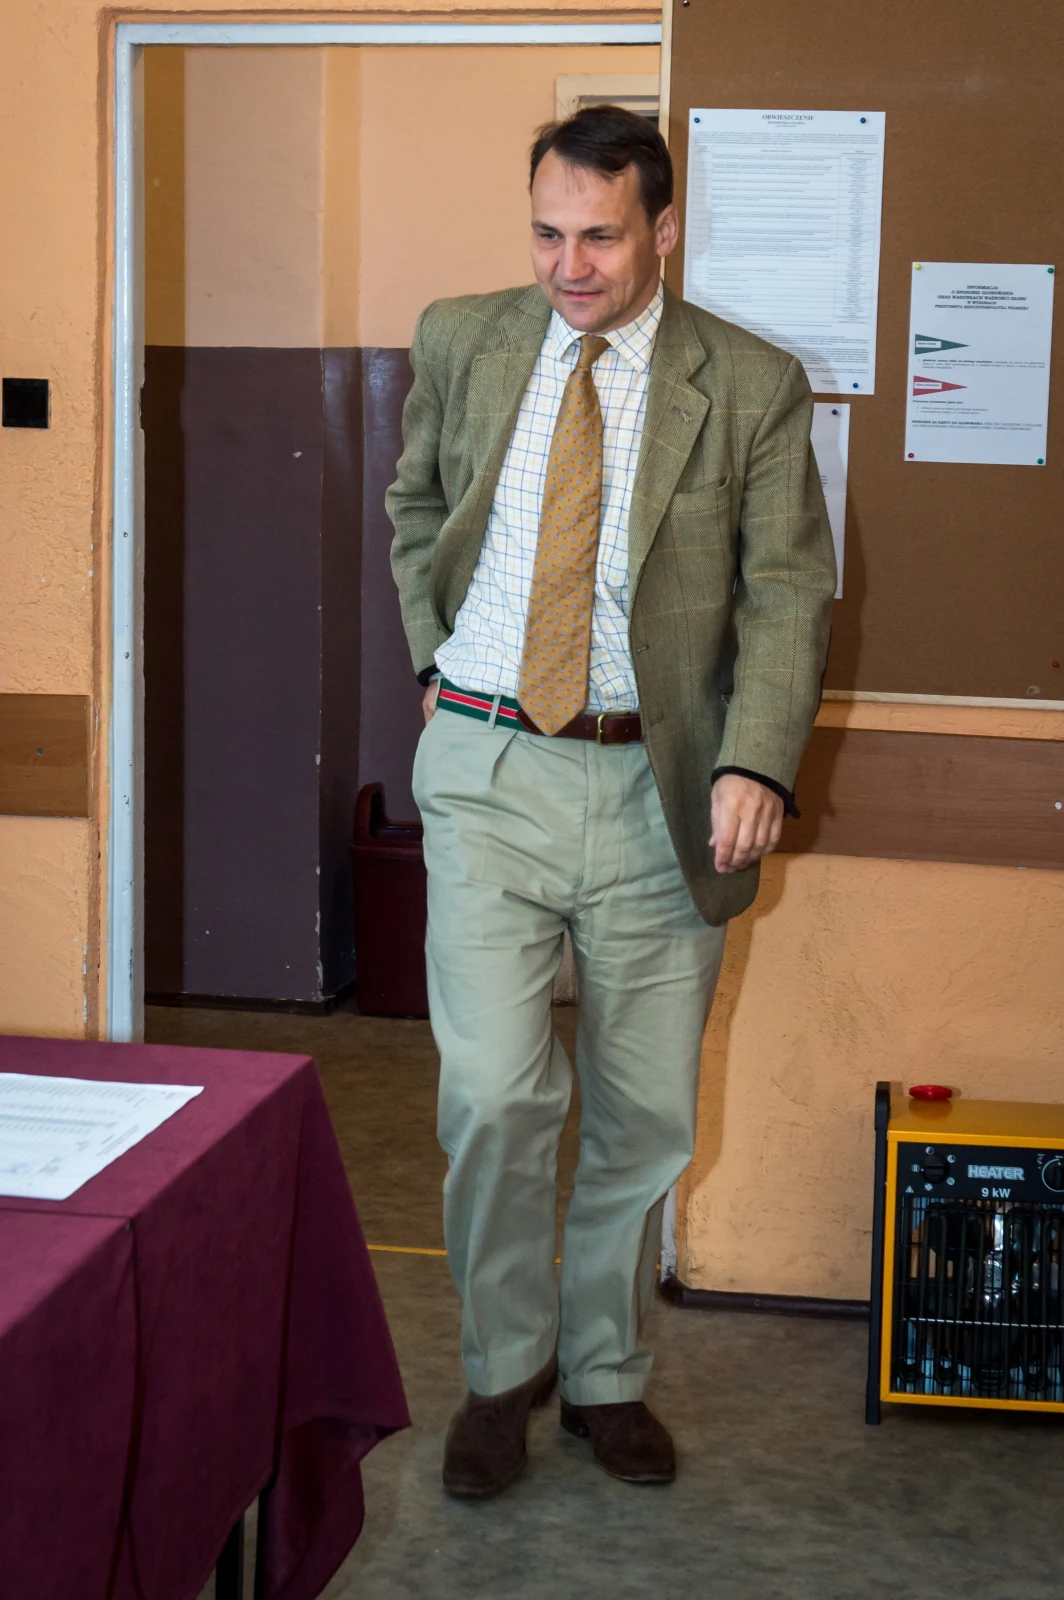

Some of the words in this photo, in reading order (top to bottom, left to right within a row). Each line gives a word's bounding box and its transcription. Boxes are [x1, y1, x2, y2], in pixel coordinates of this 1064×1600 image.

[968, 1165, 1025, 1180] HEATER
[981, 1188, 989, 1197] 9
[992, 1188, 1011, 1198] kW
